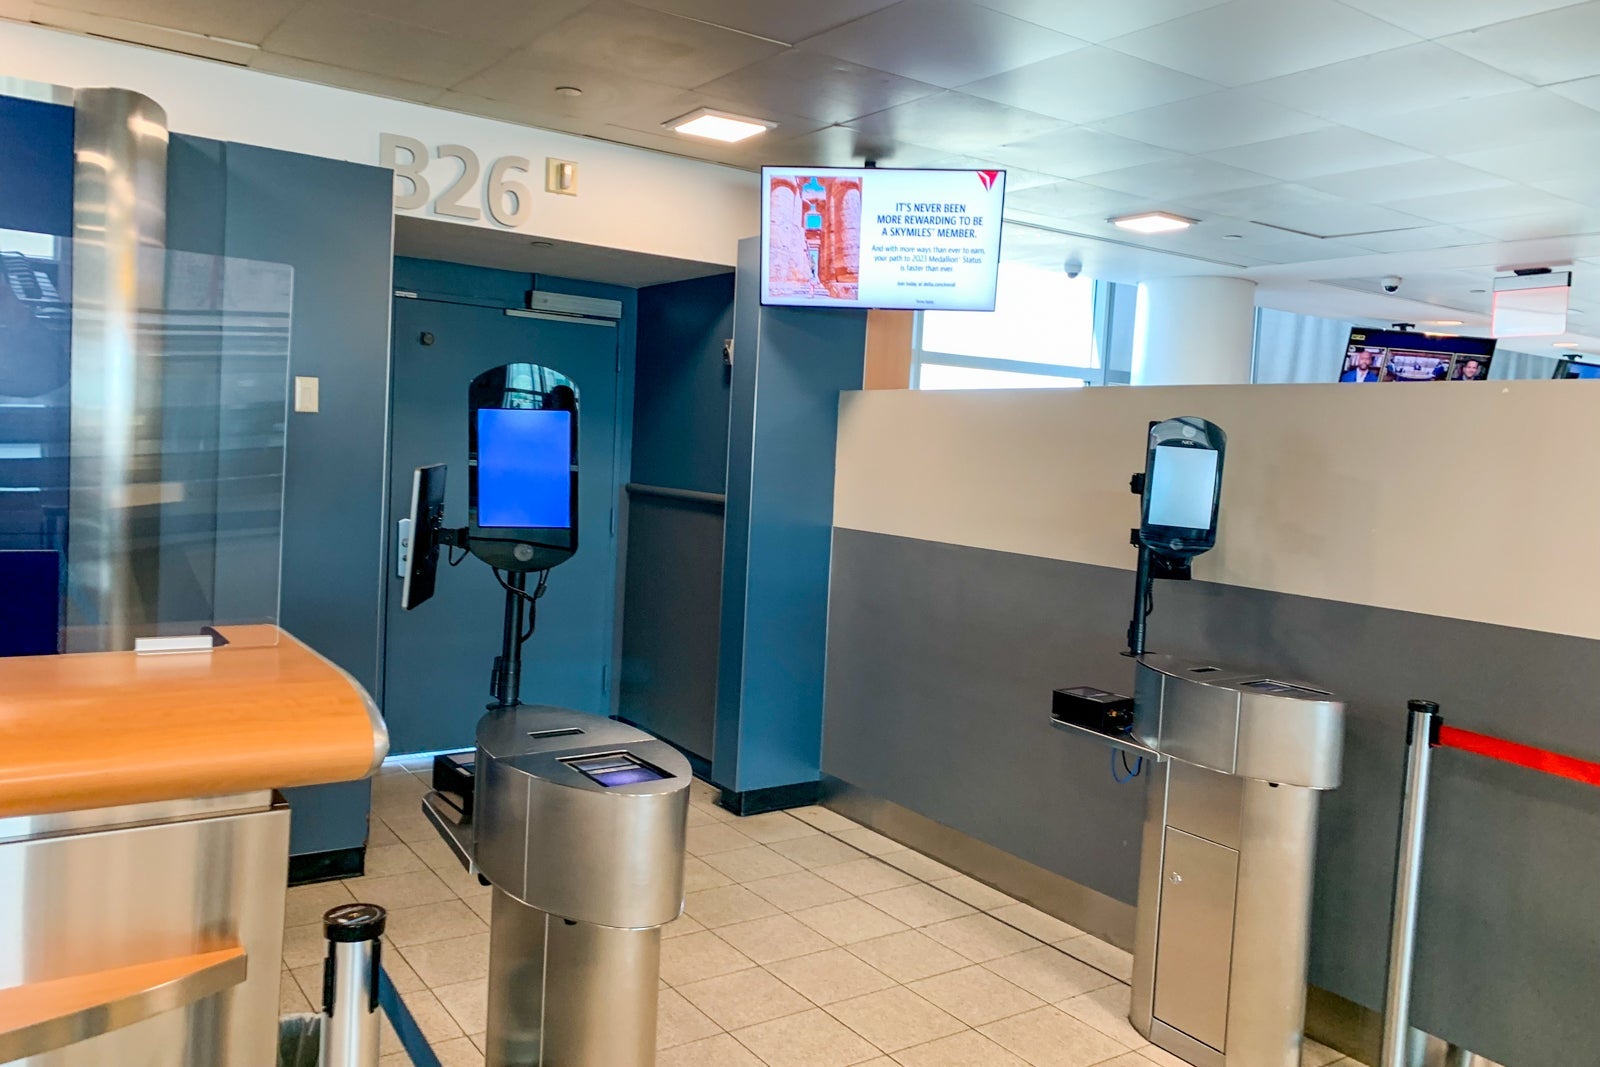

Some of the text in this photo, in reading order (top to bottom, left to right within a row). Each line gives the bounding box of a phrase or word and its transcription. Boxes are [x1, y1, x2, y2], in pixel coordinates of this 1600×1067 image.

[379, 132, 533, 228] B26
[895, 202, 966, 213] IT'S NEVER BEEN
[877, 215, 984, 226] MORE REWARDING TO BE
[881, 227, 888, 237] A
[937, 228, 977, 238] MEMBER.
